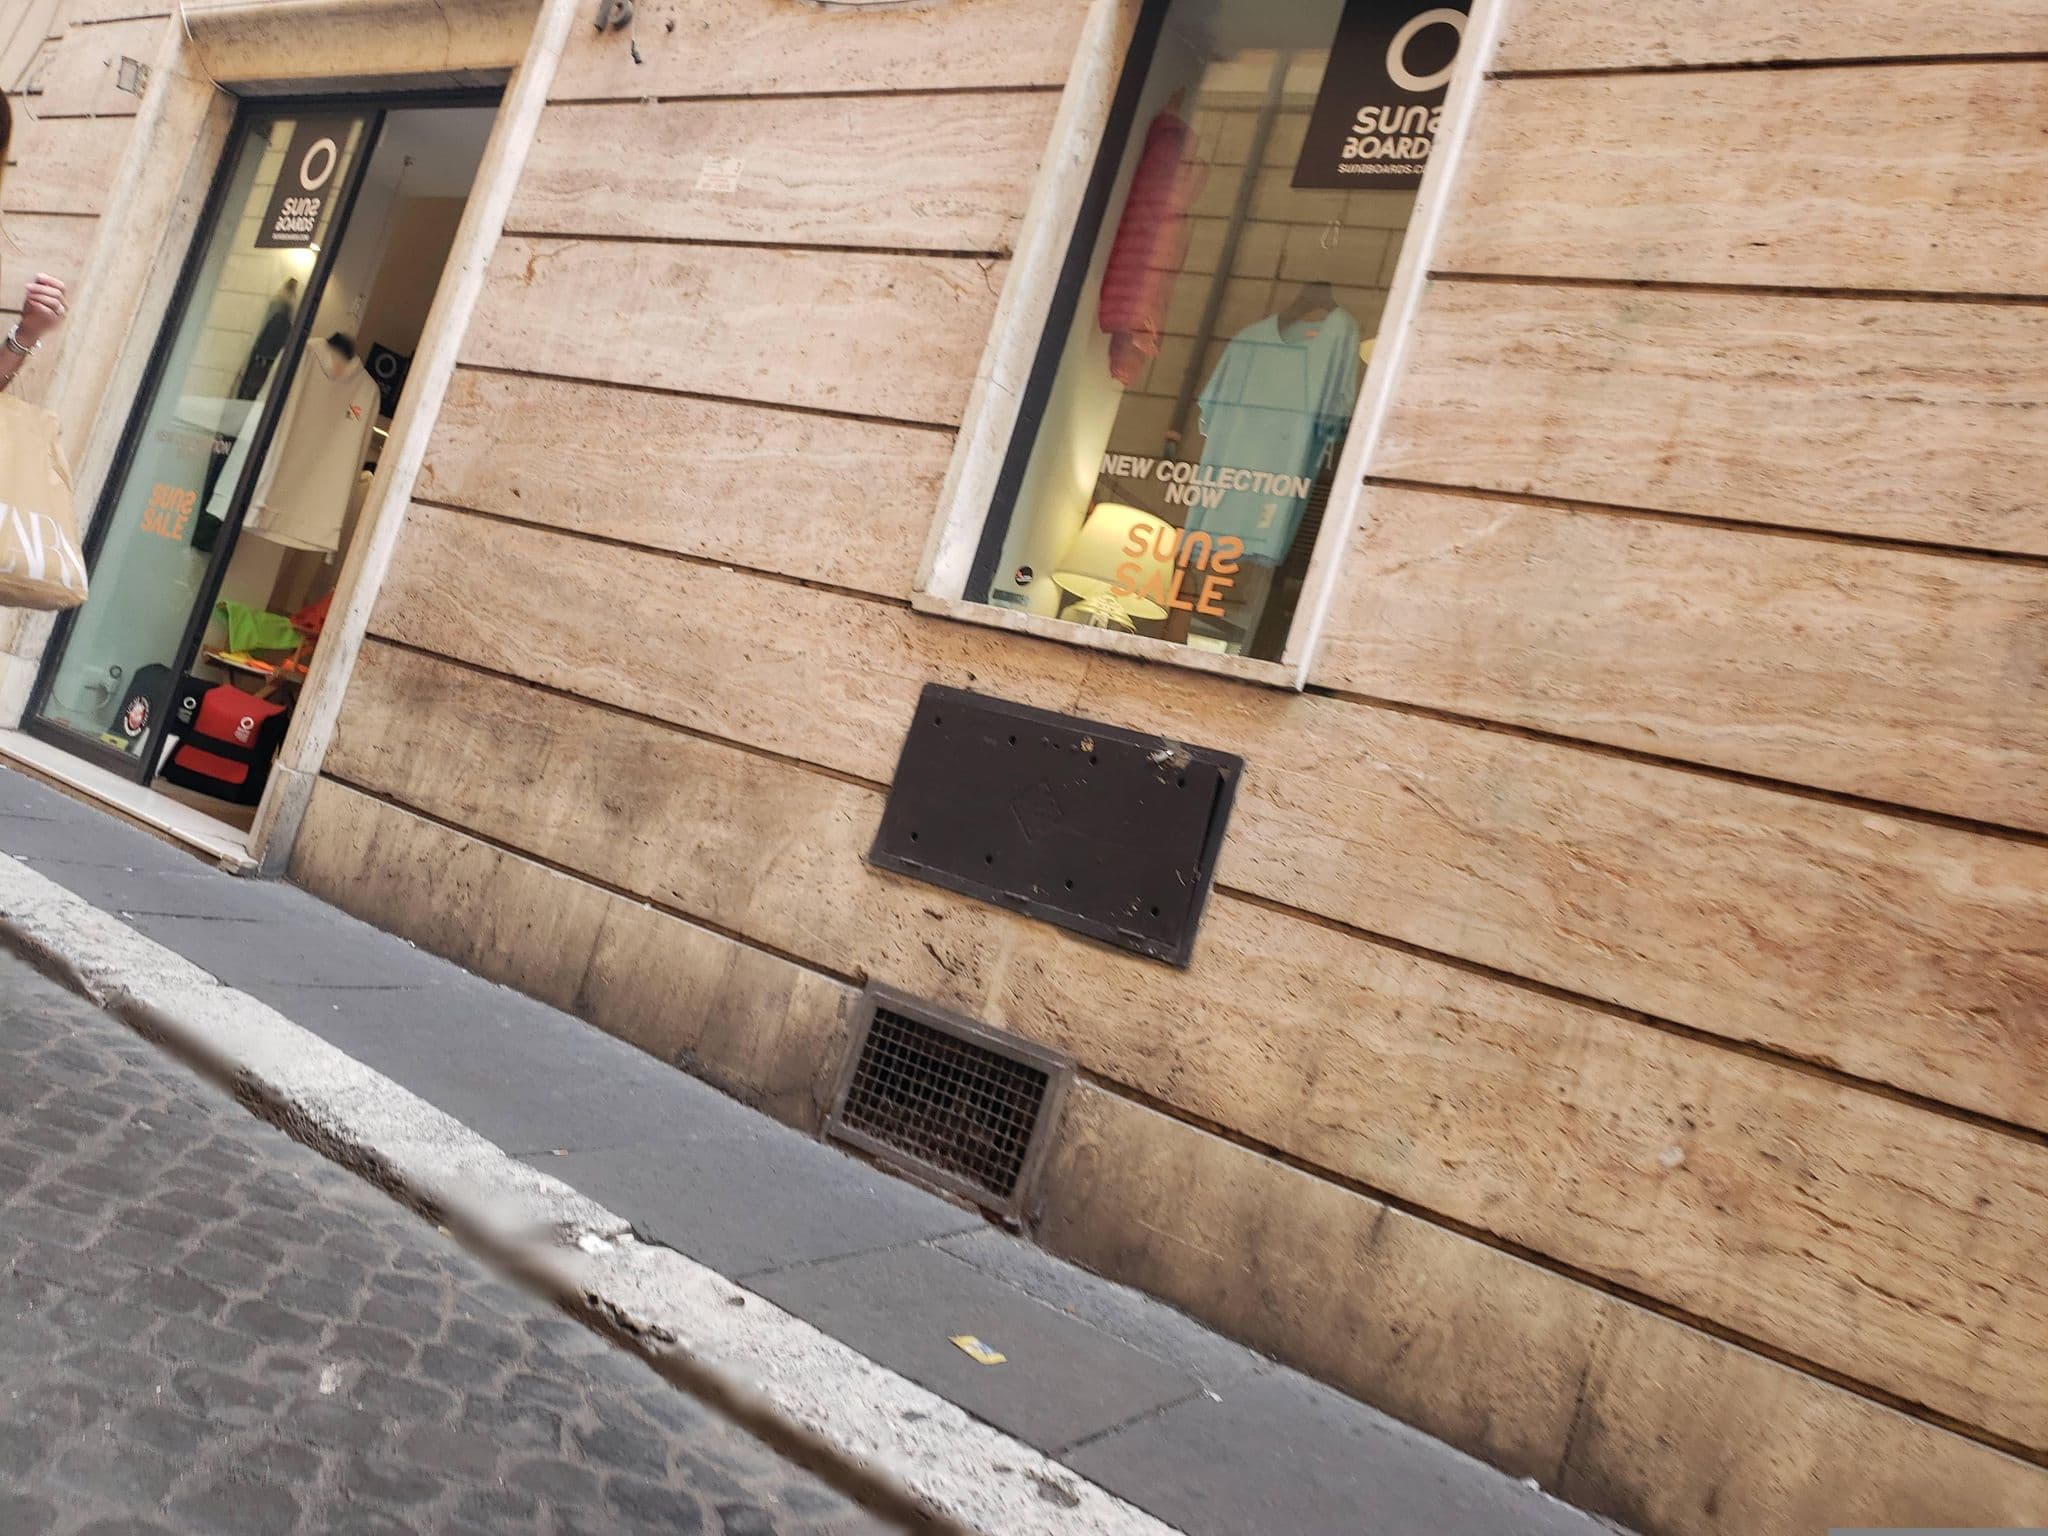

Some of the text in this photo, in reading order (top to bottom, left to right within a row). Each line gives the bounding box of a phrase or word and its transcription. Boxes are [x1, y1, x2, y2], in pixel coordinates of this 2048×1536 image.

[1341, 136, 1433, 159] BOARD
[1101, 453, 1312, 500] NEW COLLECTION
[1164, 484, 1226, 509] NOW
[140, 507, 189, 541] SALE
[1110, 562, 1234, 618] SALE
